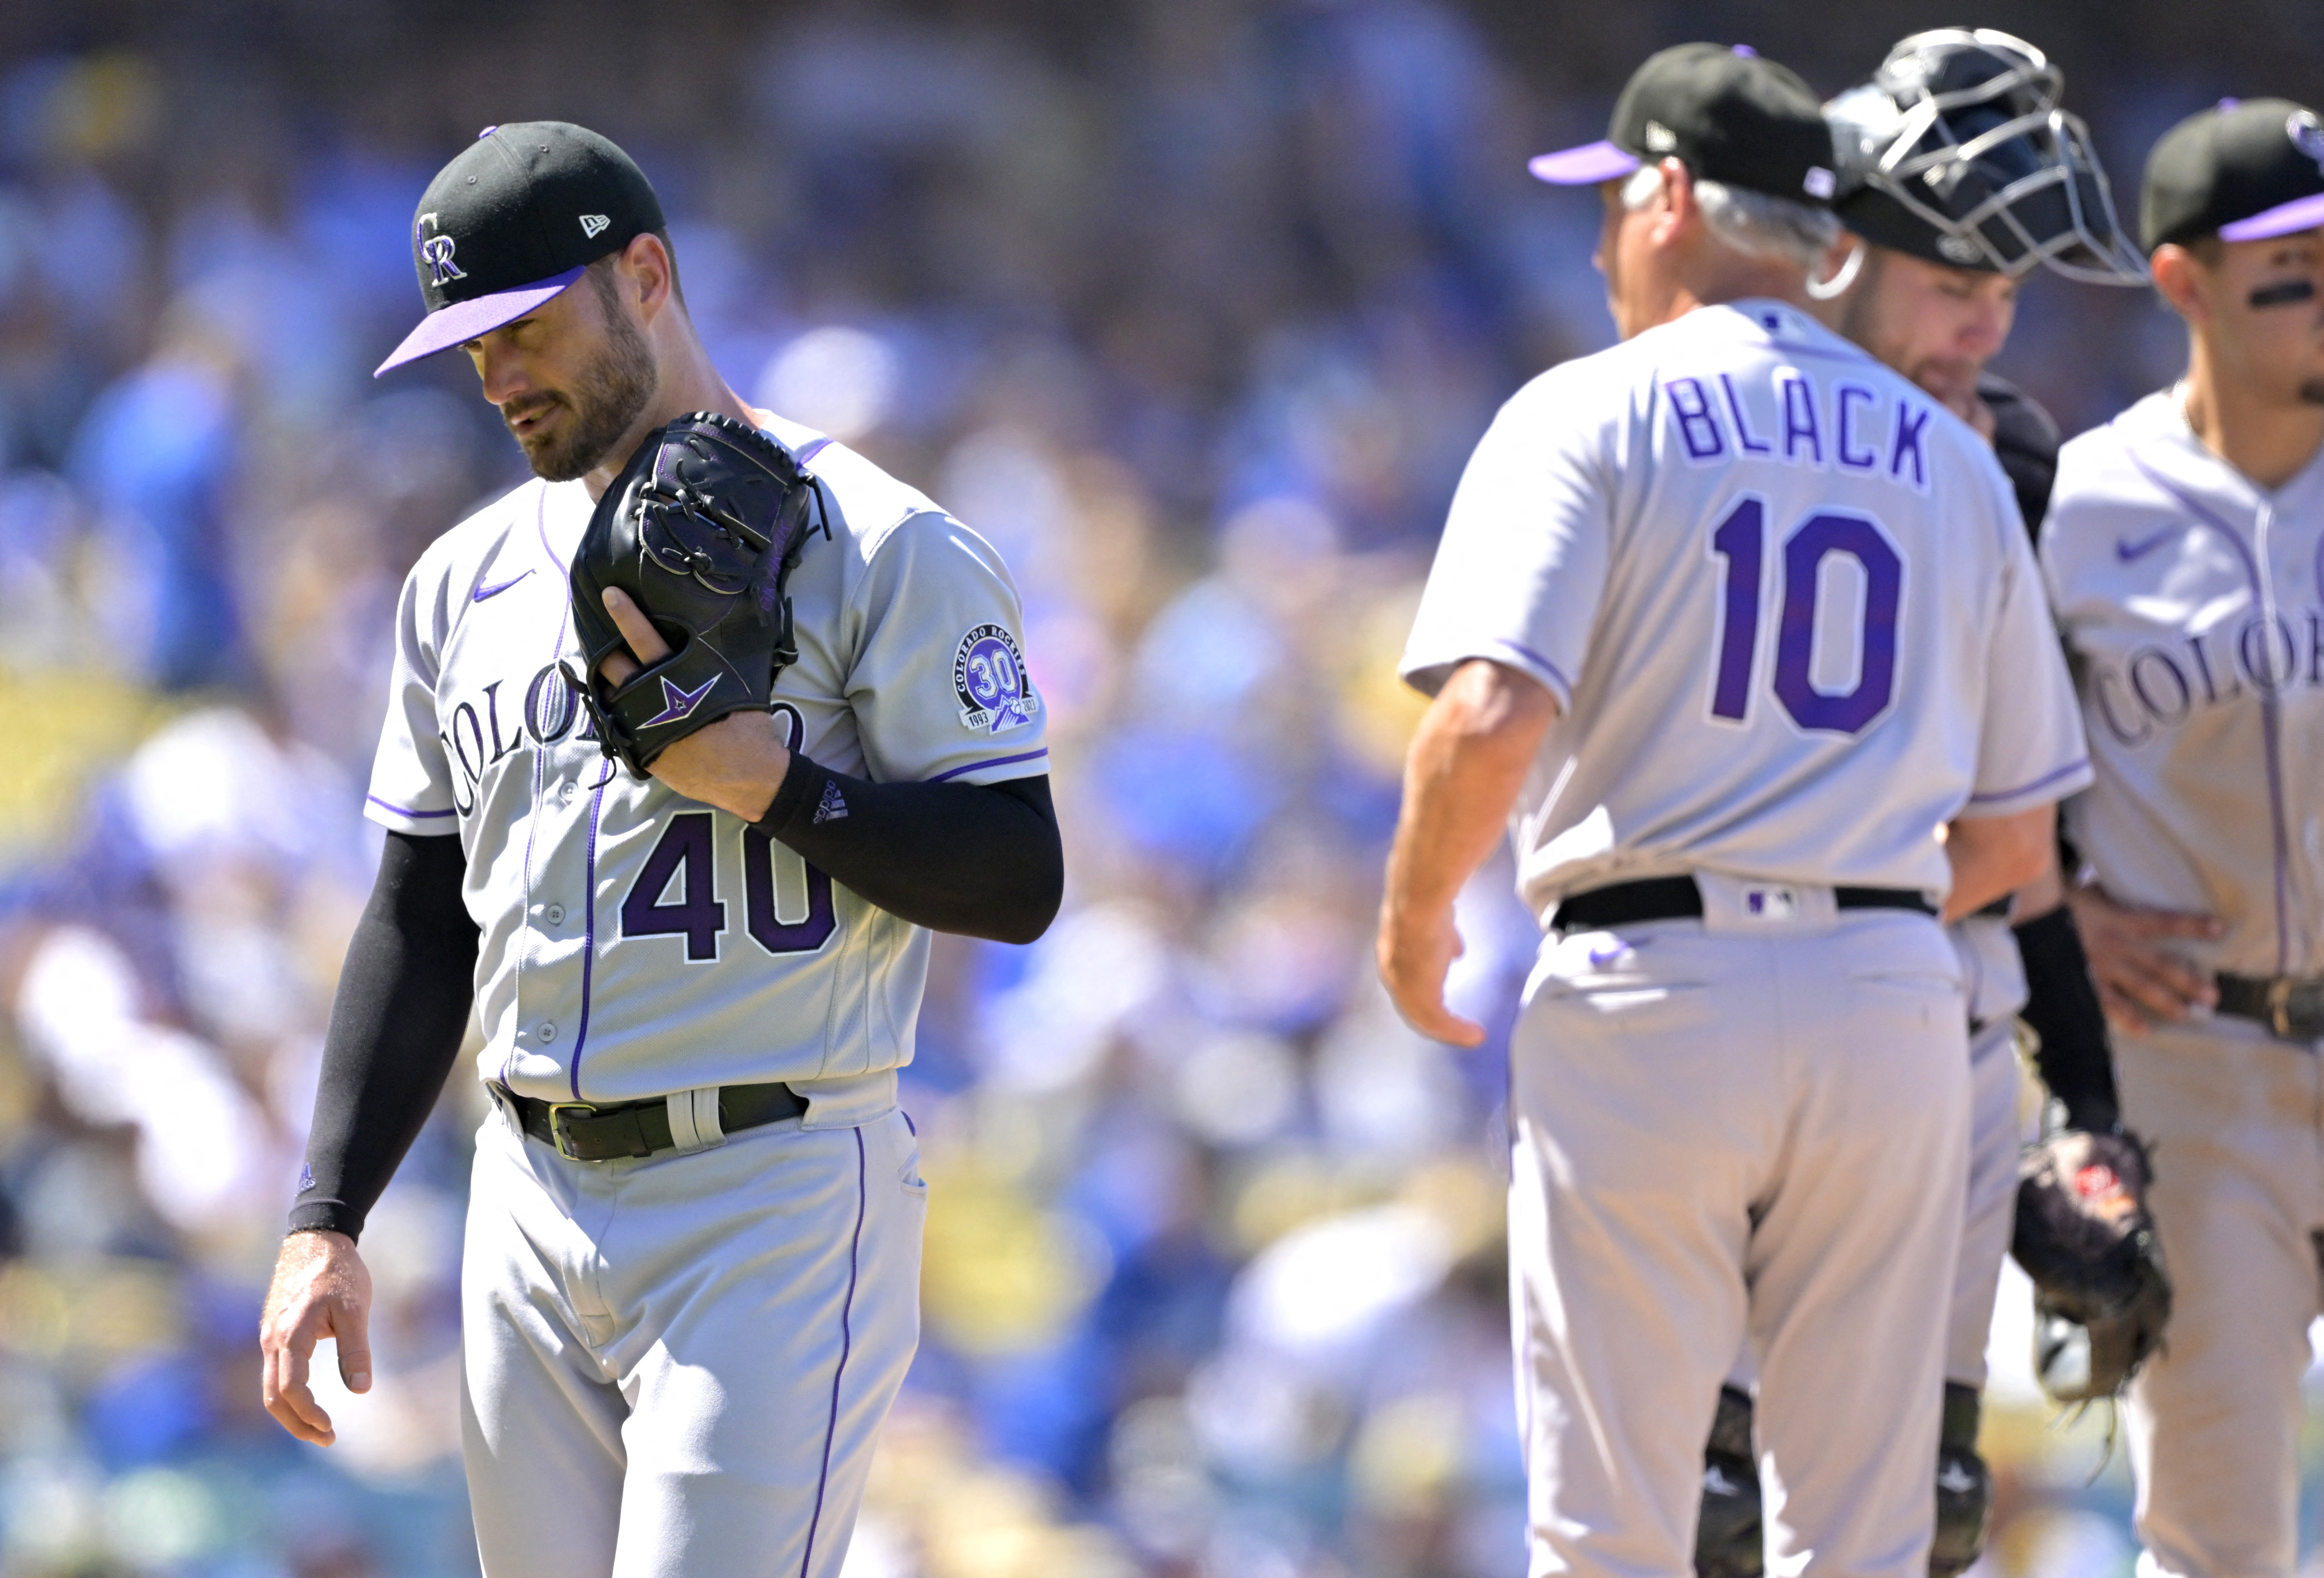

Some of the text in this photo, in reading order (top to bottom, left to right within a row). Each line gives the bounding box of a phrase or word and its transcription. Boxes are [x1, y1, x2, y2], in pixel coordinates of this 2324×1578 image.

[1664, 372, 1928, 488] BLACK
[1709, 496, 1905, 736] 10
[955, 626, 1026, 692] COLORADO ROCKIES
[969, 648, 1017, 700] 30
[968, 711, 989, 727] 1993
[813, 780, 836, 824] adidas
[618, 809, 840, 964] 40
